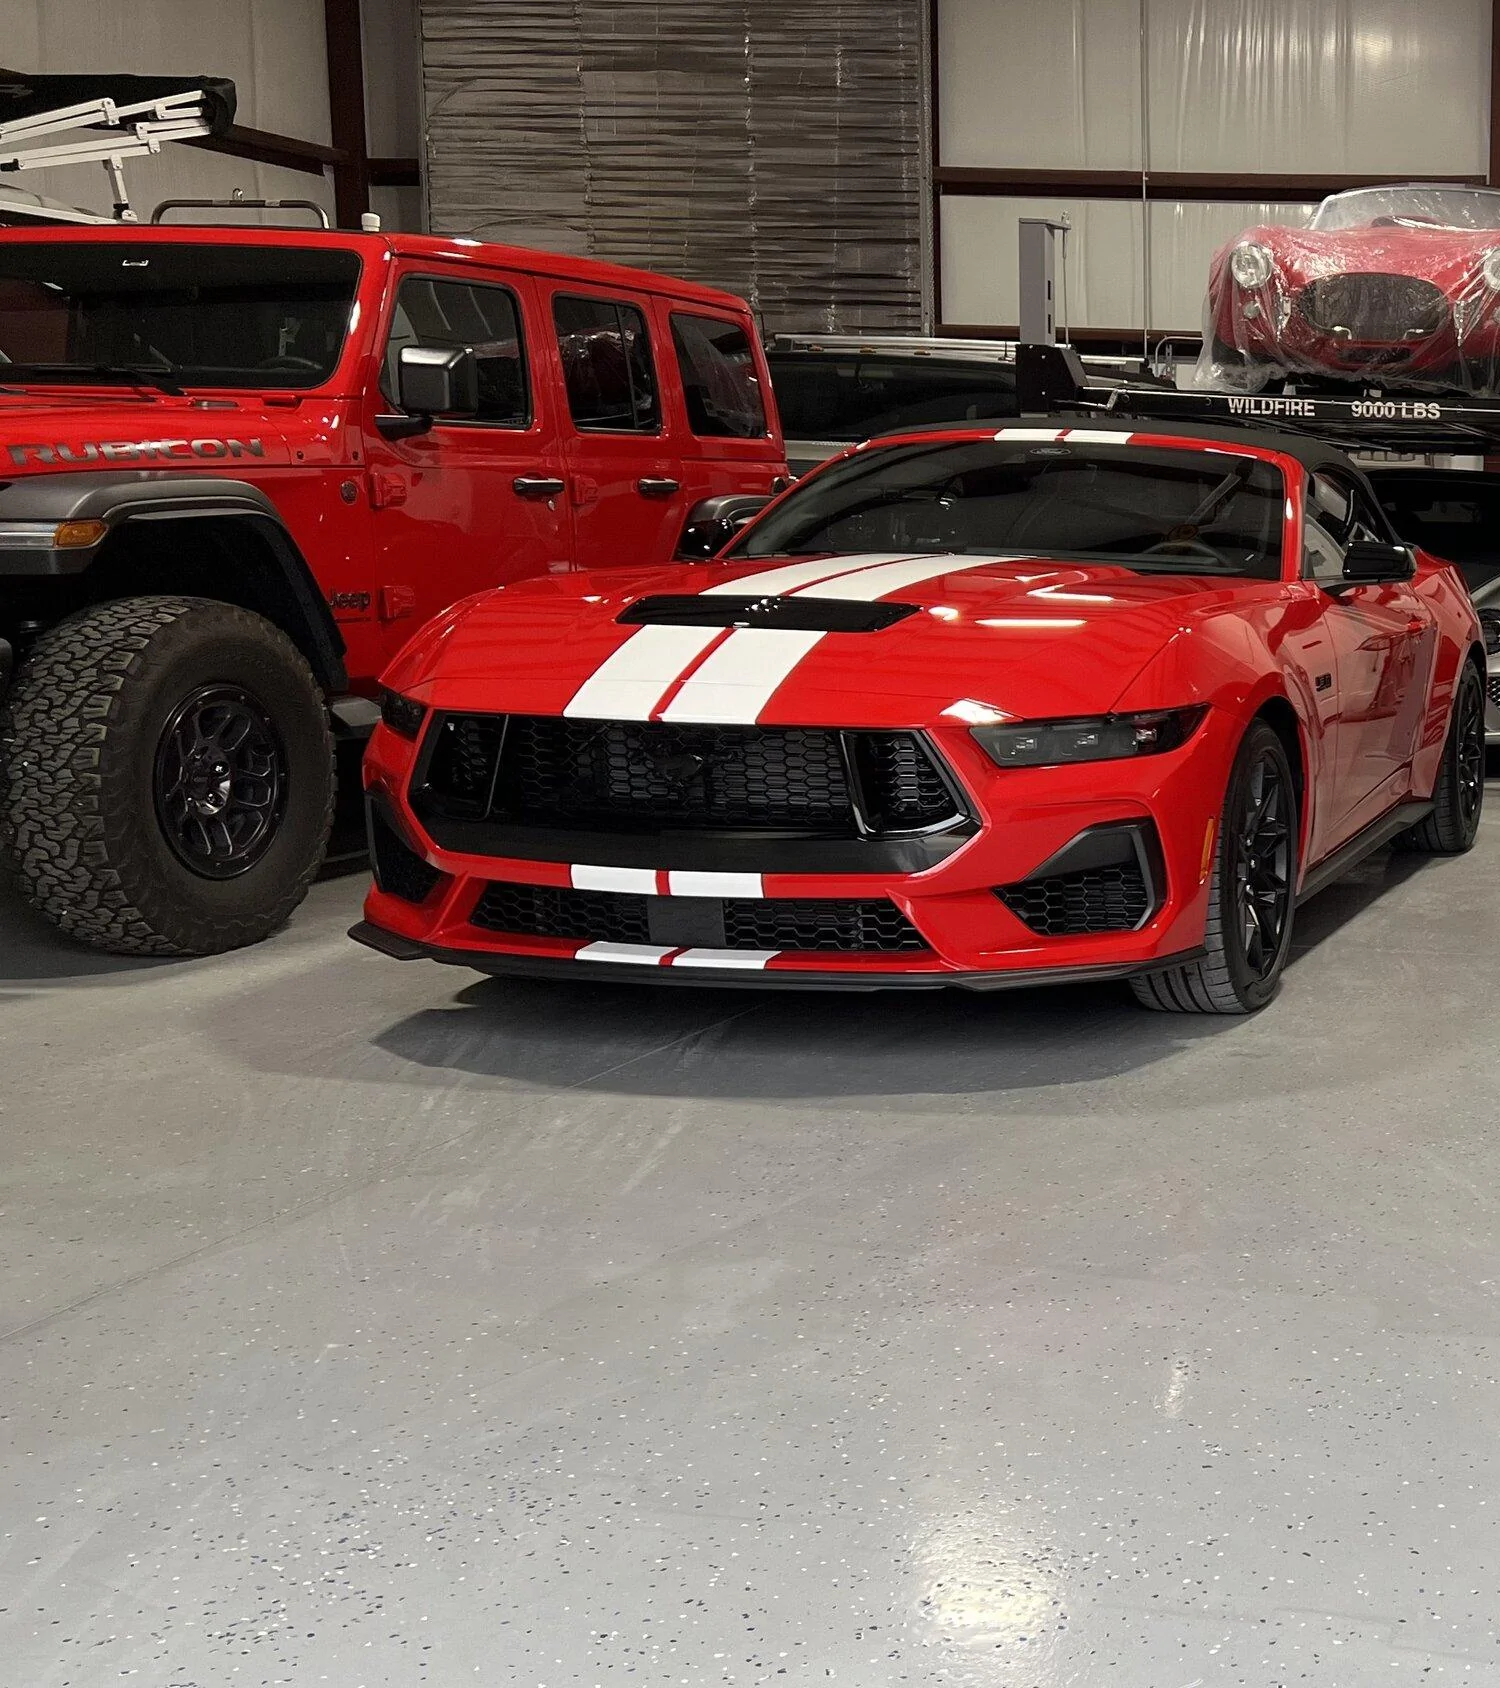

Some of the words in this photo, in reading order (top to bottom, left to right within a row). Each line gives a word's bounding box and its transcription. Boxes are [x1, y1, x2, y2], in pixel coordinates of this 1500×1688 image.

[1228, 397, 1316, 417] WILDFIRE
[1352, 401, 1396, 419] 9000
[1401, 402, 1441, 420] LBS
[8, 438, 265, 466] RUBICON
